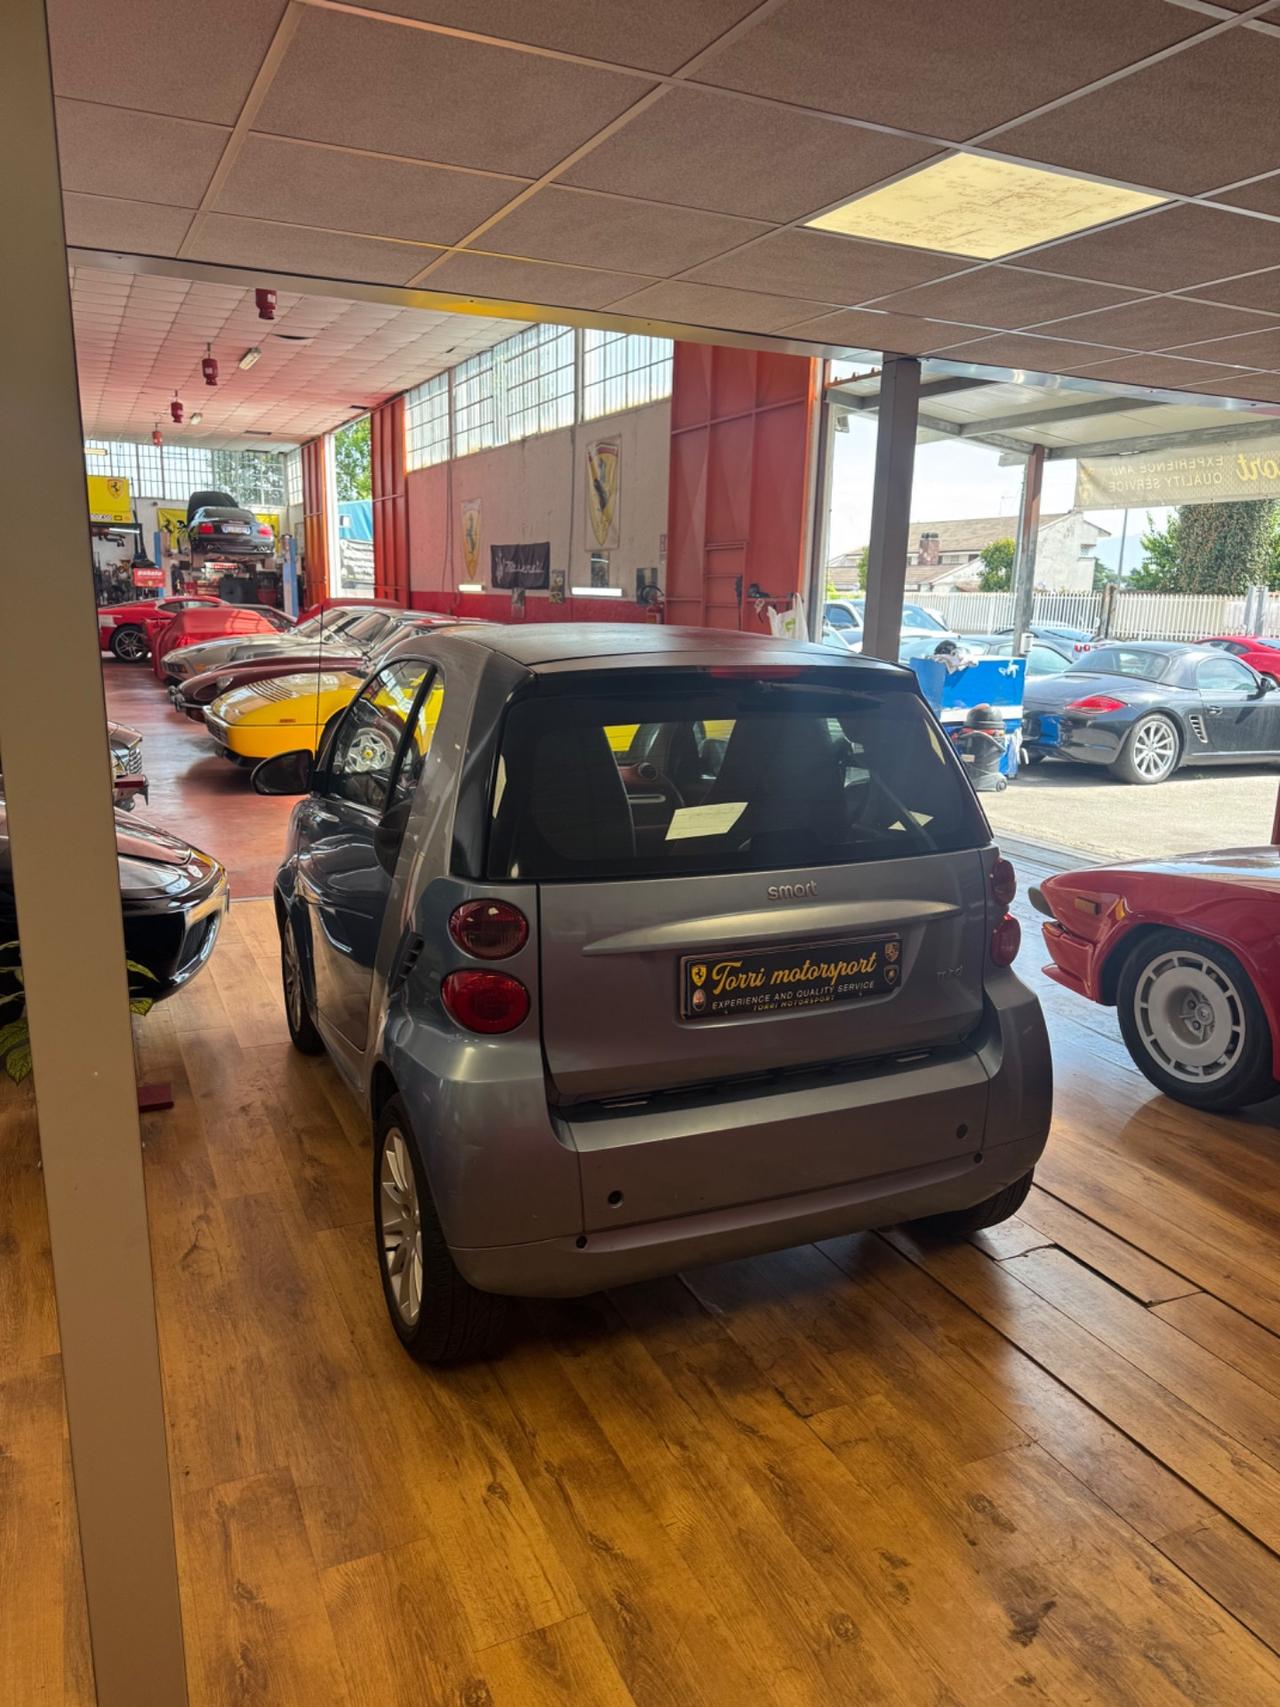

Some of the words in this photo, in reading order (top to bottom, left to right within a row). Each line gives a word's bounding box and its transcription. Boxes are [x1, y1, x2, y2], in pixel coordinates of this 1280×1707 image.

[767, 880, 818, 900] smart
[711, 960, 766, 995] Torri
[769, 951, 878, 987] motorsport
[712, 993, 770, 1010] EXPERIENCE
[774, 991, 793, 1001] AND
[796, 985, 836, 998] QUALITY
[837, 980, 875, 993] SERVICE
